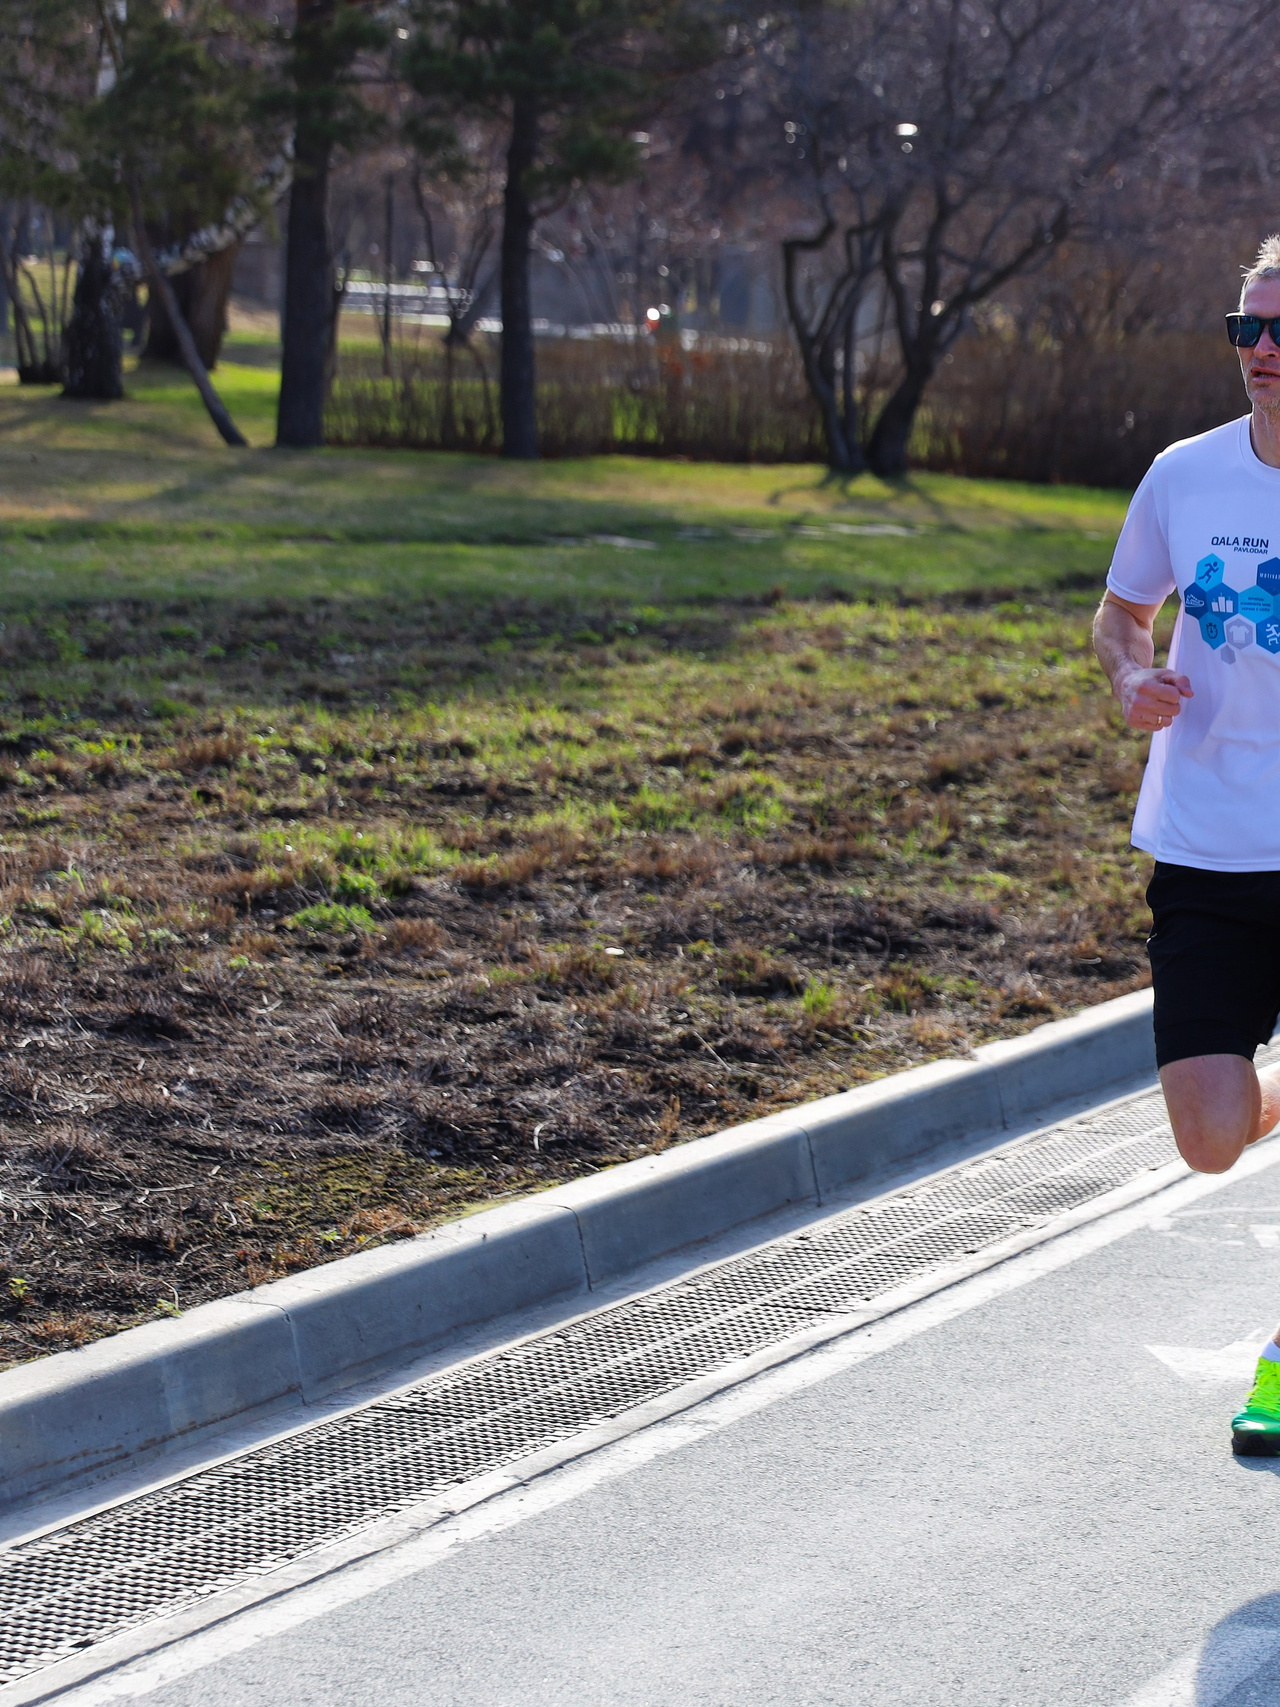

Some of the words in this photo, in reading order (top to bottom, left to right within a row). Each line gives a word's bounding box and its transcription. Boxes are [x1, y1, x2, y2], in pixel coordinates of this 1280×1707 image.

[1211, 536, 1239, 546] QALA
[1243, 537, 1269, 548] RUN
[1233, 546, 1268, 555] PAVLODAR
